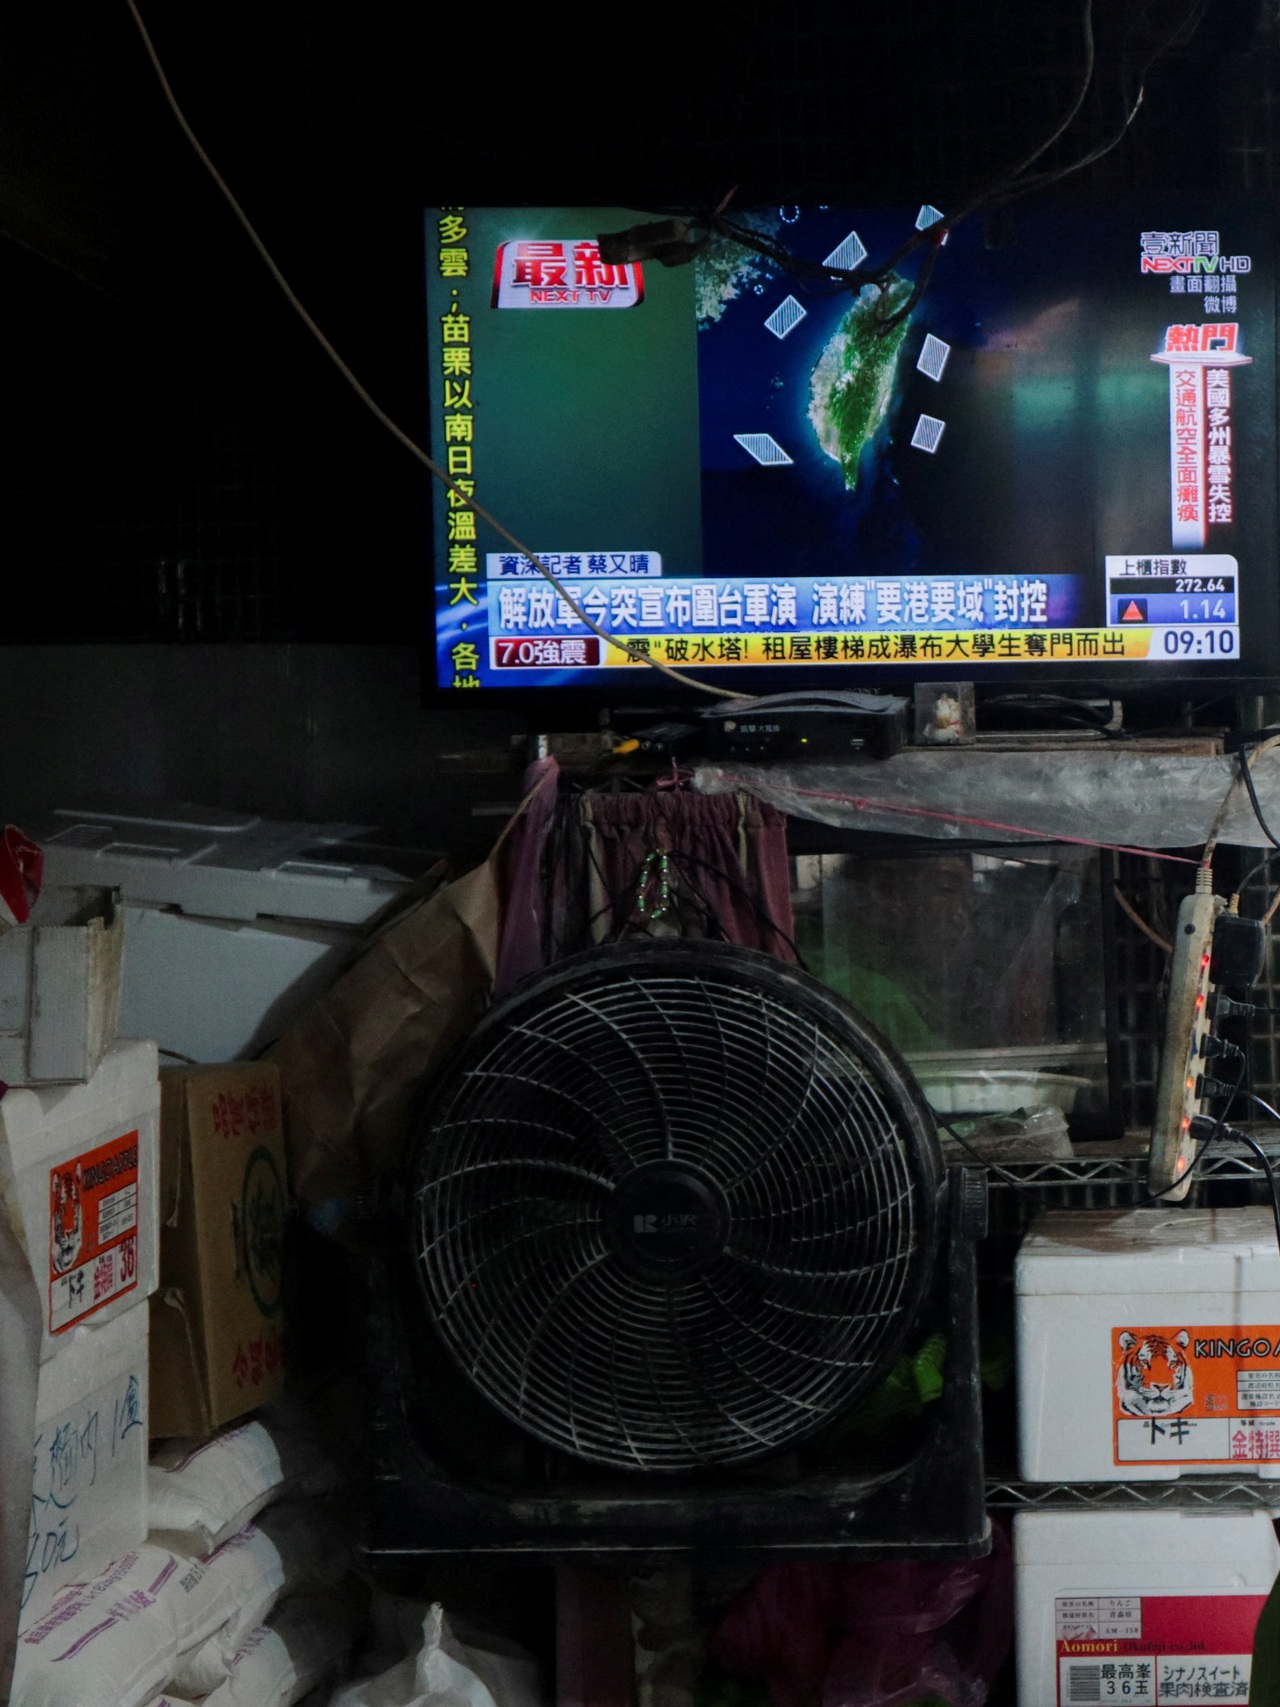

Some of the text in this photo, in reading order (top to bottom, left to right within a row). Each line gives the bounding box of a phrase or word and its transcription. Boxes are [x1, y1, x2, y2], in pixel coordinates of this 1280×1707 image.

[1140, 231, 1219, 256] 壹新聞
[512, 242, 629, 287] 最新
[1219, 256, 1251, 273] HD
[1169, 275, 1237, 293] 畫面翻攝
[529, 289, 613, 304] NEXT TV
[1204, 295, 1237, 314] 微博
[1166, 322, 1238, 352] 熱門
[1175, 369, 1199, 522] 交通航空全面癱瘓
[1206, 369, 1232, 523] 美國多州暴雪失控
[499, 555, 650, 575] 資深記者 蔡又晴
[1119, 558, 1187, 576] 上櫃指數
[1175, 578, 1225, 592] 272.64
[499, 583, 796, 630] 解放軍今突宣布圍台軍演
[1179, 598, 1226, 620] 1.14
[498, 639, 587, 665] 7.0強震
[762, 632, 1125, 661] 租屋樓梯成瀑布大學生奪門而出
[1163, 630, 1234, 655] 09:10
[1059, 1639, 1118, 1653] Aomori
[1163, 1665, 1241, 1682] シナノスイート
[1158, 1682, 1249, 1697] 果肉検査済
